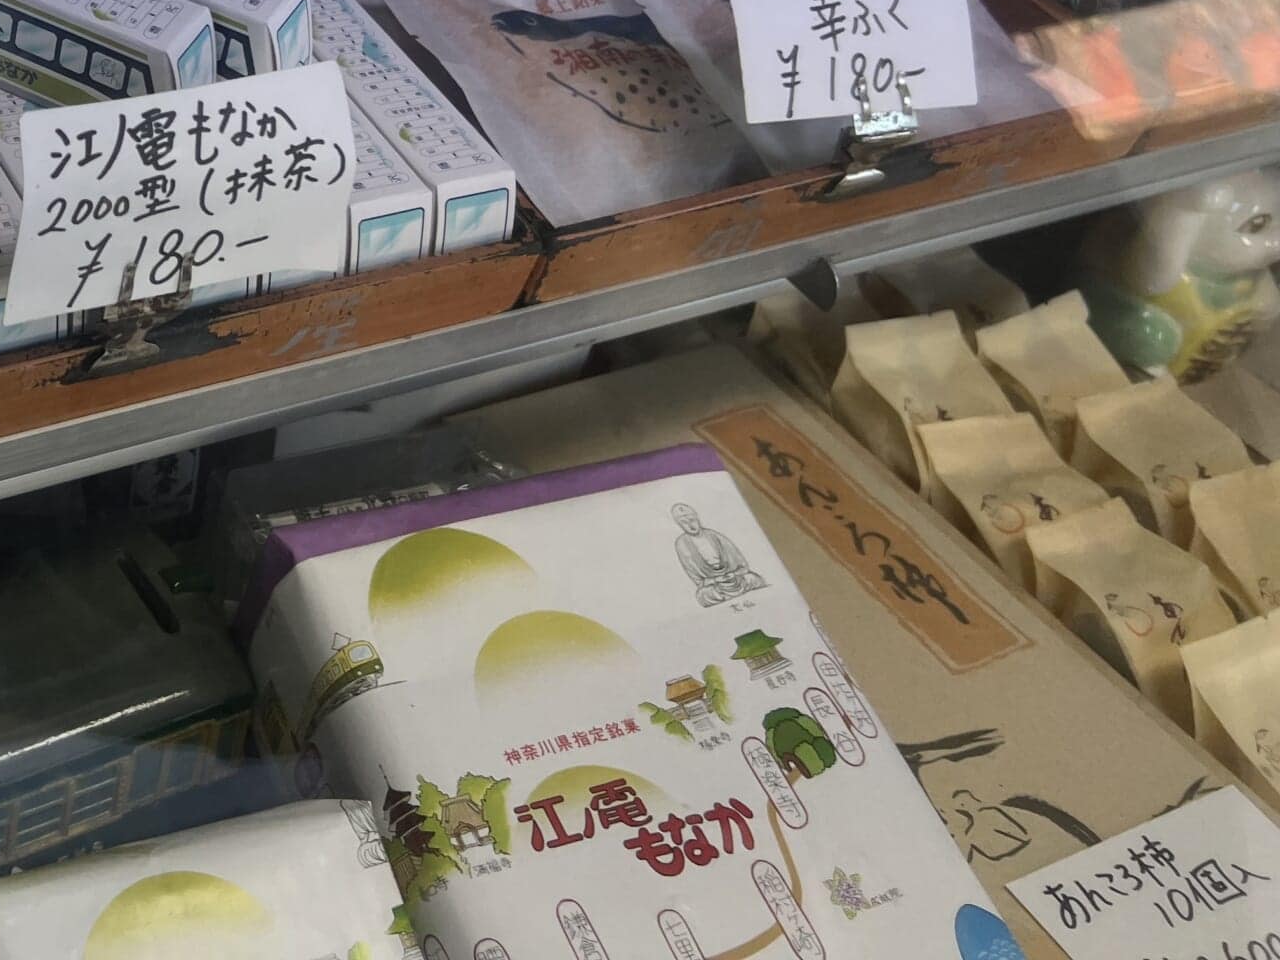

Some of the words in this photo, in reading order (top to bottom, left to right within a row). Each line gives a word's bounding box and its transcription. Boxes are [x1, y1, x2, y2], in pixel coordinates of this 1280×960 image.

[49, 99, 297, 180] 江ノ電もなか
[503, 717, 642, 767] 神奈川県指定銘菓
[513, 777, 653, 852] 江ノ電
[623, 797, 755, 877] もなか
